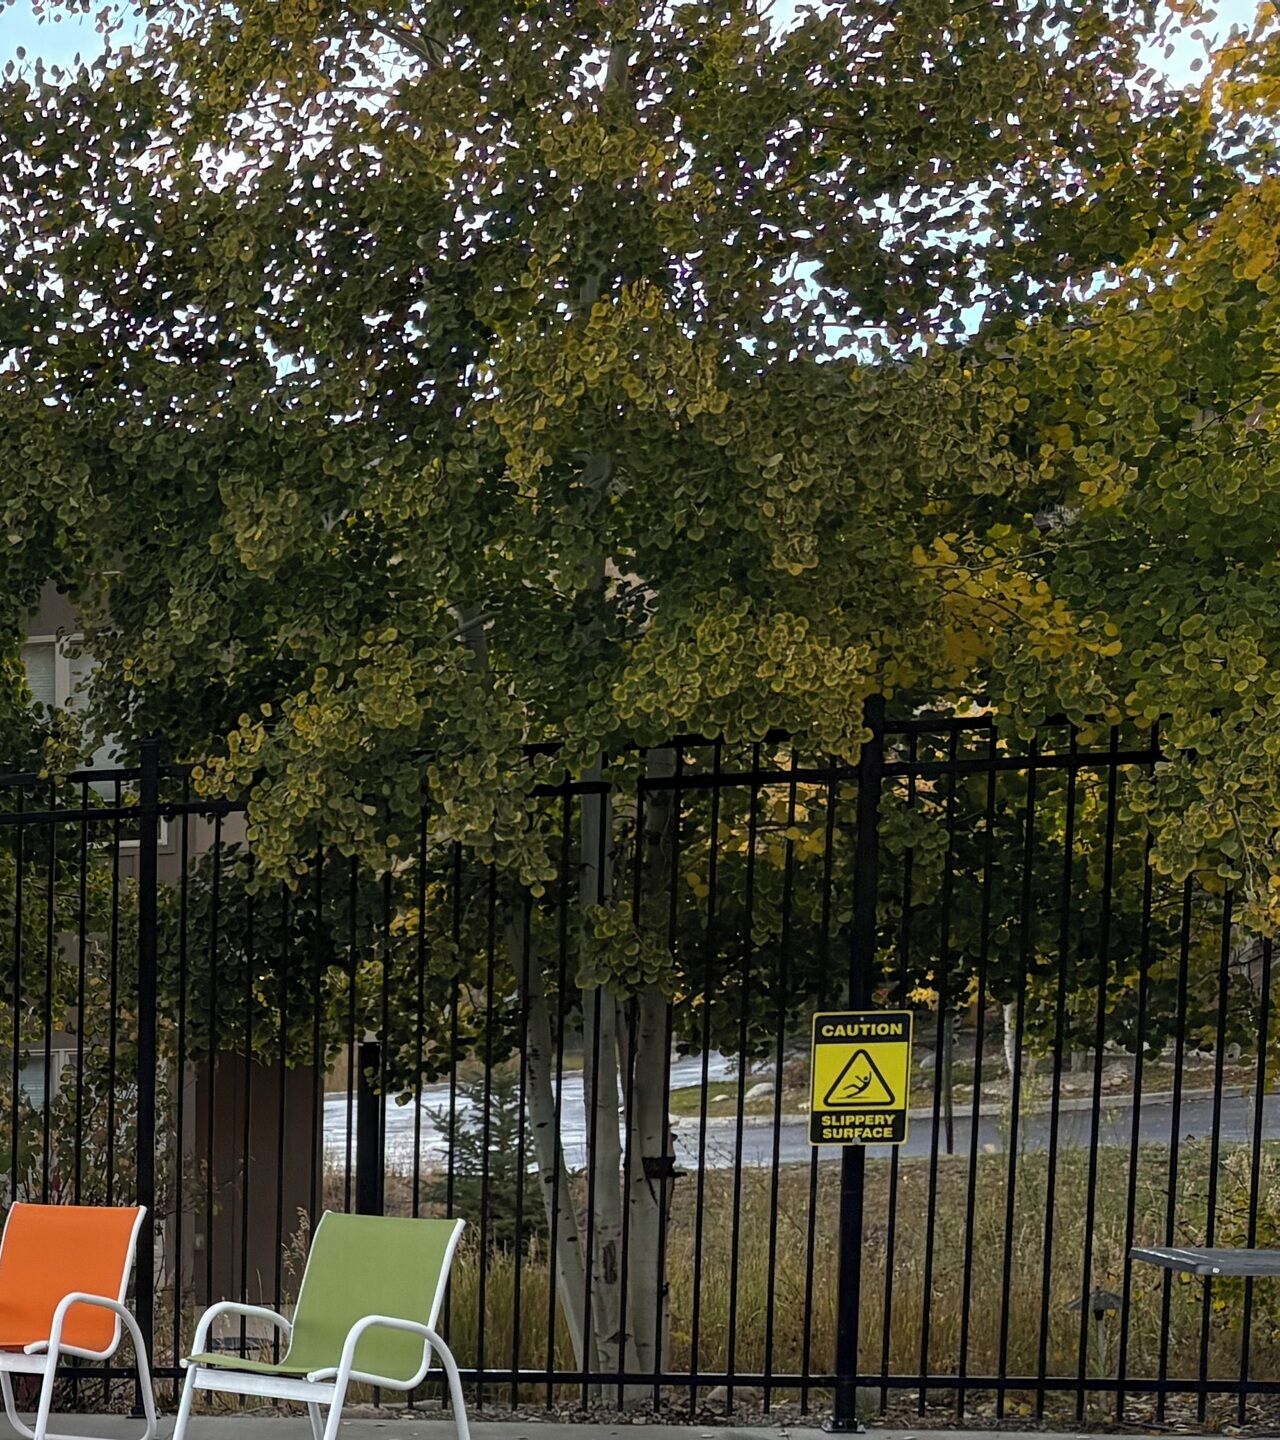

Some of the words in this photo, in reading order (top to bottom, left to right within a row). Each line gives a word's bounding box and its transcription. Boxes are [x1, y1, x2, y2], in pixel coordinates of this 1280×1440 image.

[821, 1023, 903, 1037] CAUTION
[821, 1114, 896, 1127] SLIPPERY
[822, 1127, 894, 1139] SURFACE
